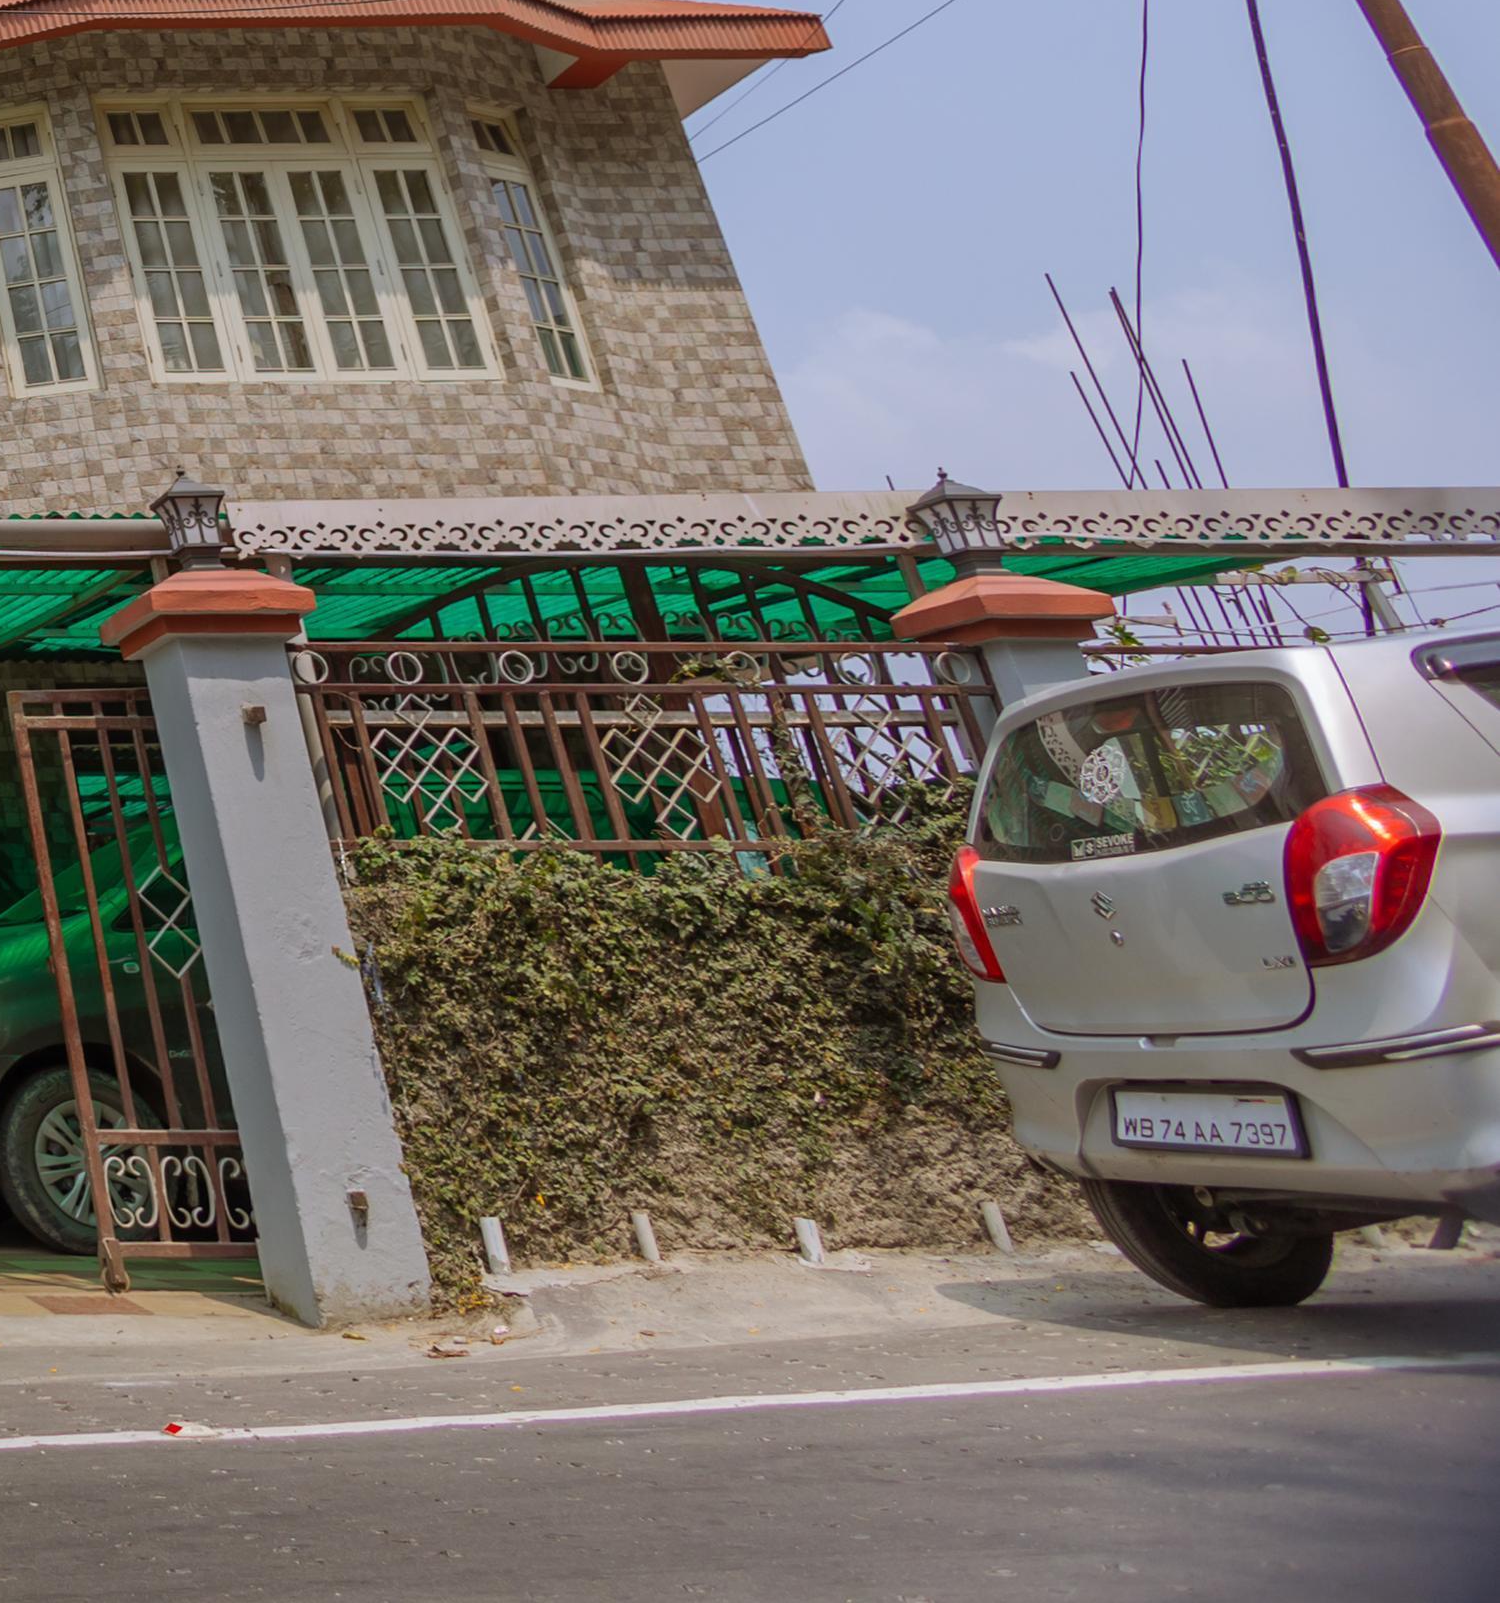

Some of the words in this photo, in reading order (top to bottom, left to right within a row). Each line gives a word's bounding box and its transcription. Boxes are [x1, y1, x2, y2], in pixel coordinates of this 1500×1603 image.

[1096, 833, 1135, 849] SEVOKE
[1124, 1117, 1154, 1139] WB
[1160, 1119, 1186, 1141] 74
[1195, 1121, 1224, 1143] AA
[1230, 1122, 1287, 1146] 7397
